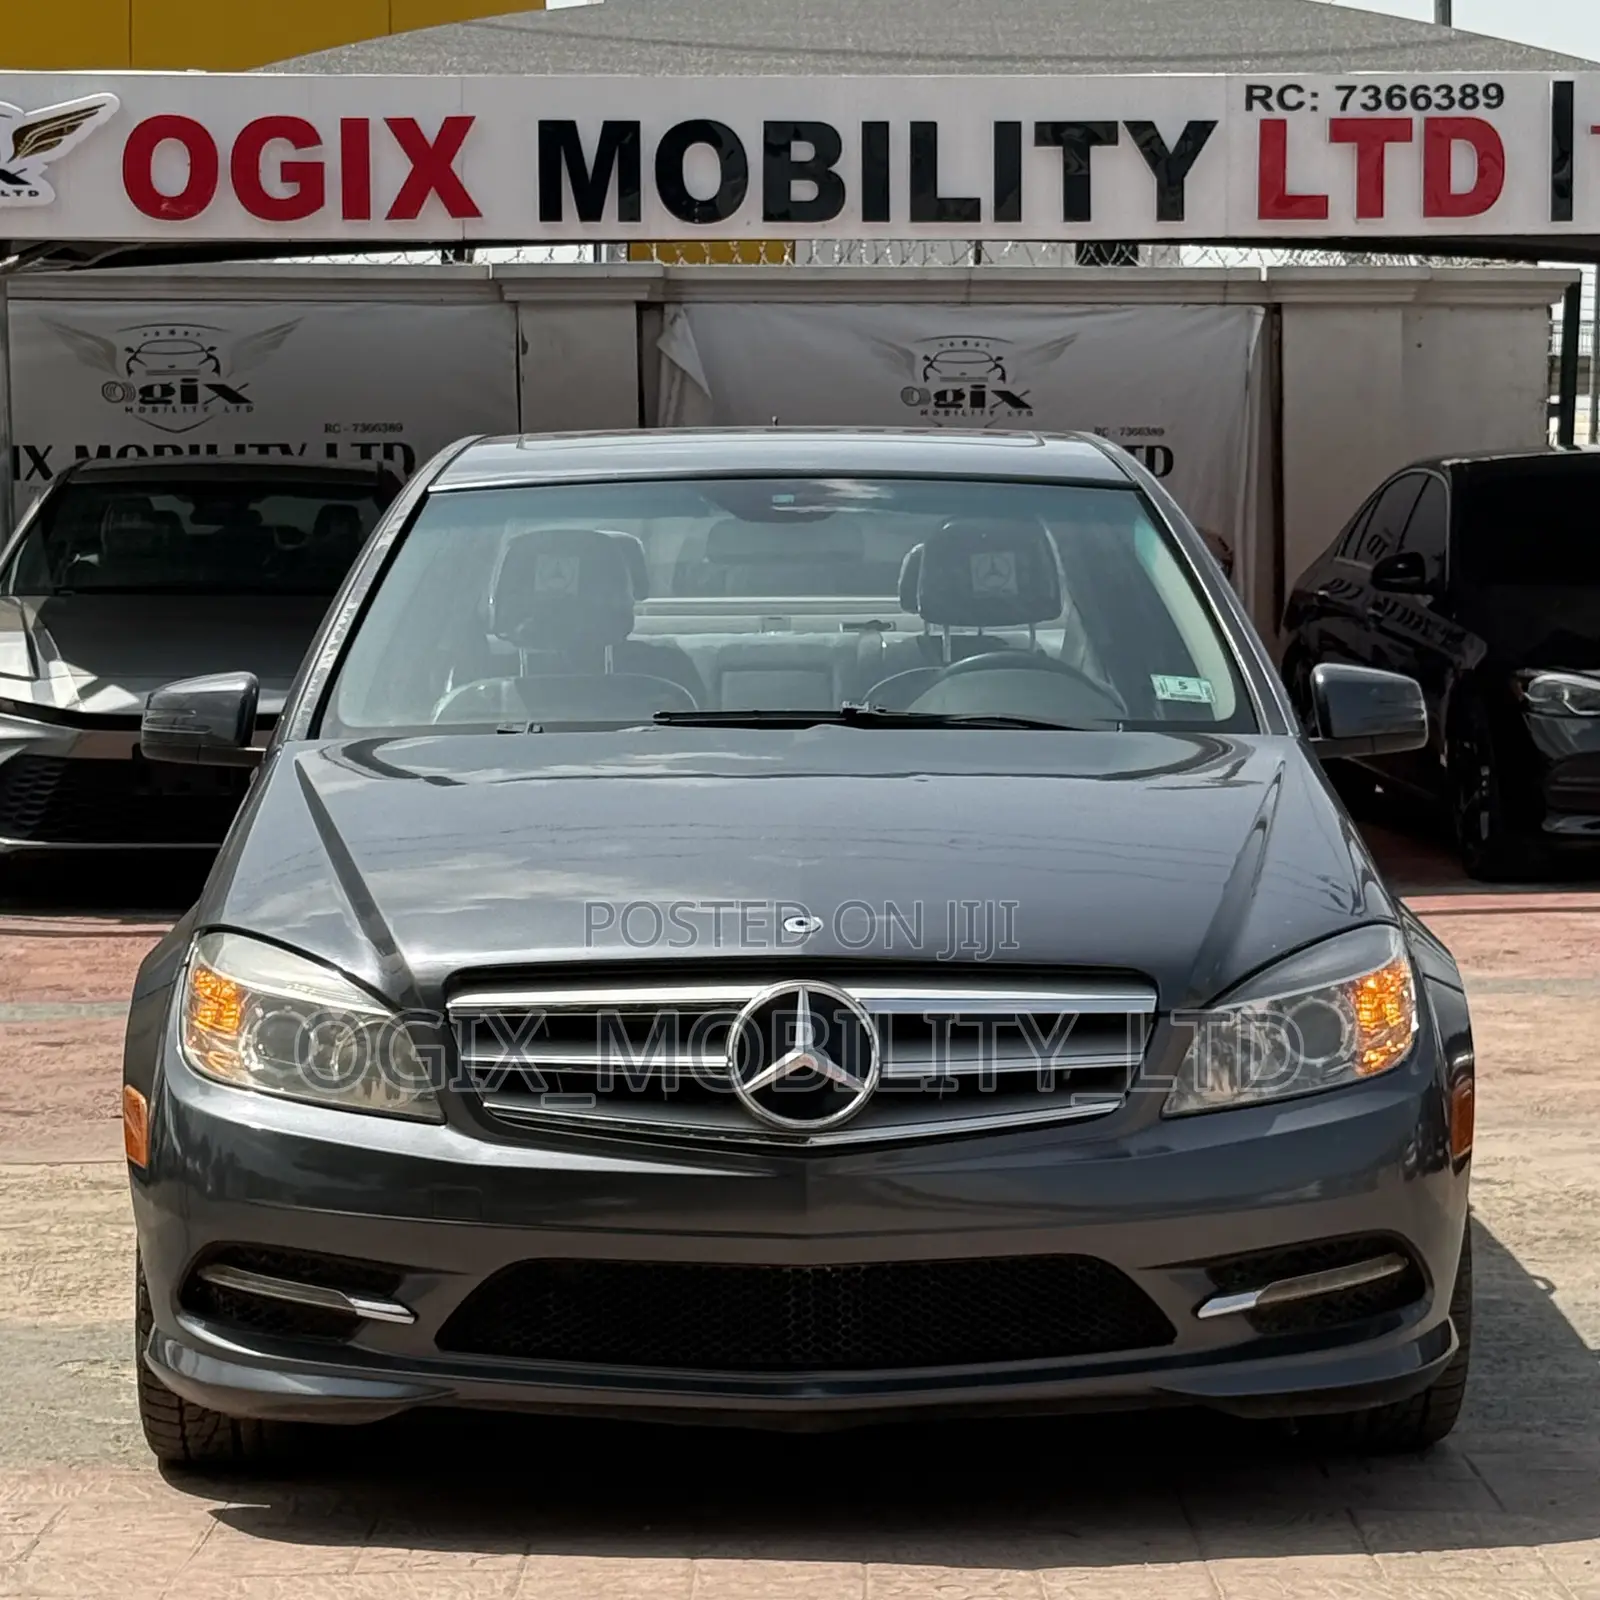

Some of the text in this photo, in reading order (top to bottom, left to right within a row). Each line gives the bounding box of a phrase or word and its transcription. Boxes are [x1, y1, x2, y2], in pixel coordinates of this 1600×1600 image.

[1245, 83, 1505, 112] RC: 7366389
[122, 114, 483, 221] OGIX
[538, 119, 1218, 224] MOBILITY
[1257, 117, 1505, 220] LTD
